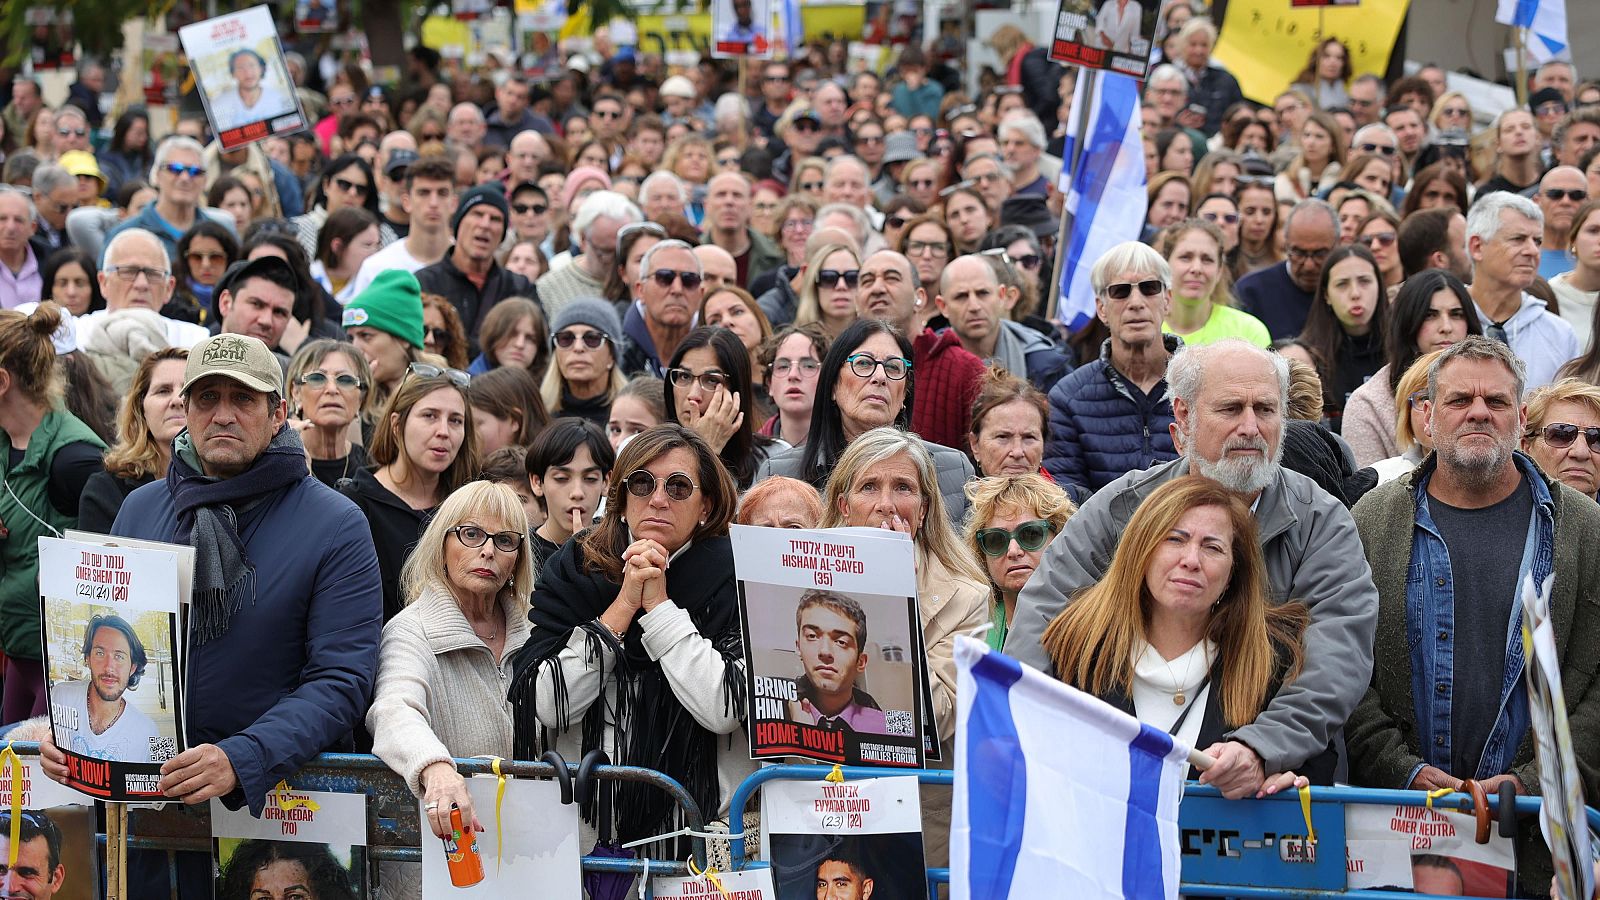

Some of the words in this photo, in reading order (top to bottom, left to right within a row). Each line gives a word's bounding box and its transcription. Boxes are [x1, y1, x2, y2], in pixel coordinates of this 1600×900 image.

[202, 349, 246, 365] BARTH
[789, 540, 821, 555] אלסייד
[824, 543, 855, 559] הישאם
[91, 553, 102, 567] שם
[103, 554, 124, 569] עומר
[782, 554, 818, 570] HISHAM
[820, 557, 864, 574] AL-SAYED
[75, 565, 92, 582] OMER
[92, 568, 112, 584] SHEM
[115, 571, 131, 585] TOV
[813, 571, 833, 587] (35)
[754, 675, 798, 702] BRING
[755, 697, 785, 720] HIM
[52, 703, 79, 731] BRING
[756, 722, 800, 746] HOME
[801, 727, 844, 754] NOW!
[861, 749, 891, 762] FAMILIES
[893, 752, 917, 764] FORUM
[81, 759, 110, 787] NOW!
[126, 782, 157, 792] FAMILIES
[815, 800, 846, 812] EVYATAR
[846, 799, 870, 812] DAVID
[265, 808, 286, 820] OFRA
[287, 809, 313, 821] KEDAR
[822, 815, 843, 829] (23)
[281, 821, 297, 835] (70)
[1390, 818, 1417, 833] OMER
[1419, 822, 1456, 837] NEUTRA
[1412, 835, 1432, 850] (22)
